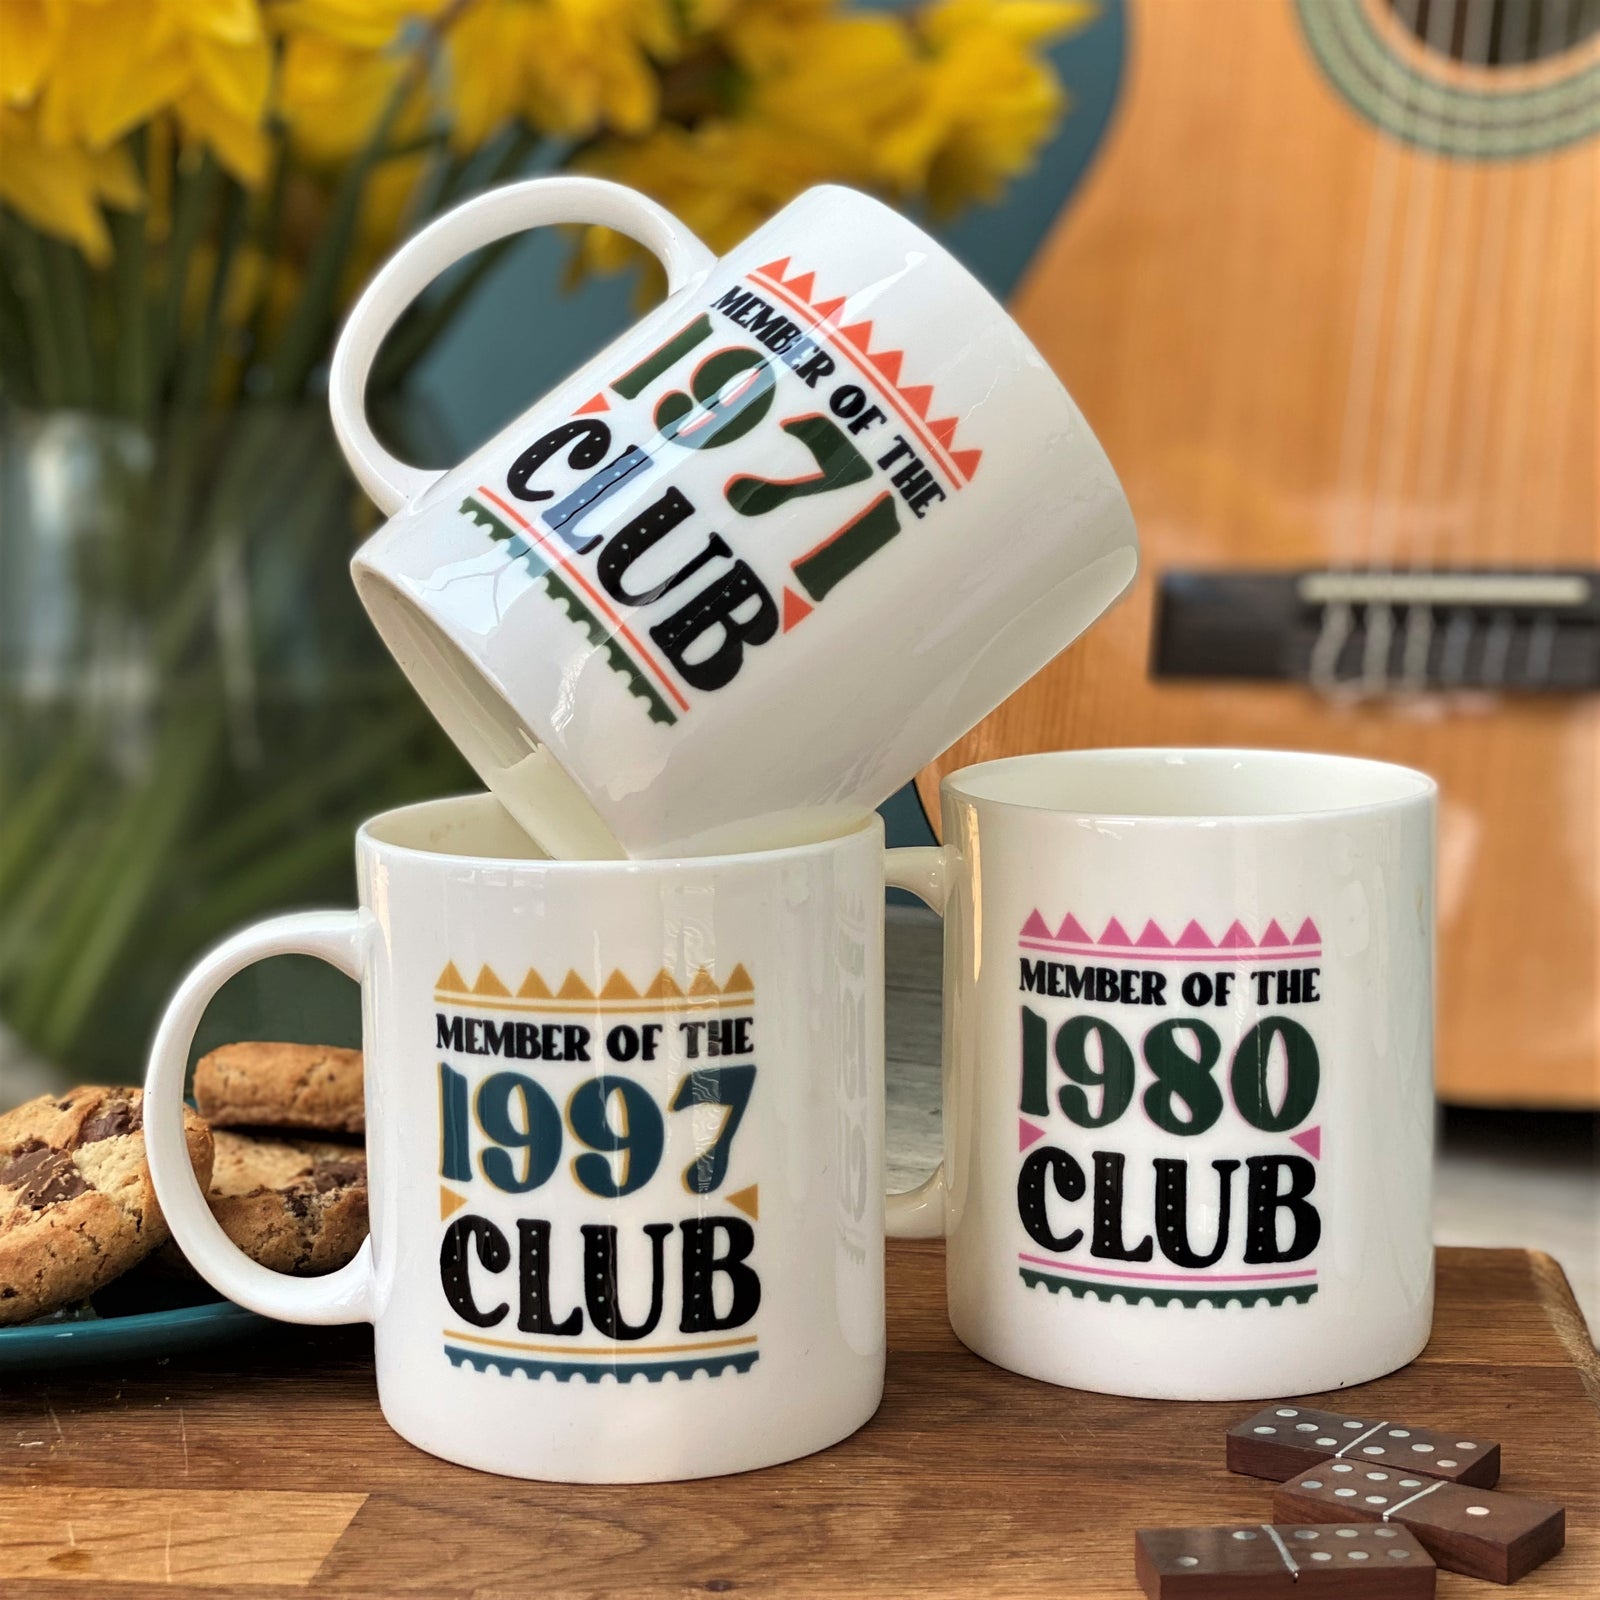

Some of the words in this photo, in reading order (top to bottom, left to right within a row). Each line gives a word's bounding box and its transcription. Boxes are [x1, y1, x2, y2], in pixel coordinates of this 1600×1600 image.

[609, 312, 902, 602] 1971
[709, 285, 836, 389] MEMBER
[829, 384, 887, 436] OF
[876, 434, 947, 519] THE
[506, 418, 780, 692] CLUB
[435, 1013, 592, 1062] MEMBER
[606, 1023, 663, 1062] OF
[680, 1016, 755, 1060] THE
[1019, 957, 1167, 1006] MEMBER
[1181, 971, 1236, 1007] OF
[1251, 967, 1321, 1006] THE
[437, 1061, 757, 1199] 1997
[1018, 1004, 1321, 1137] 1980
[1017, 1145, 1322, 1269] CLUB
[439, 1213, 762, 1341] CLUB
